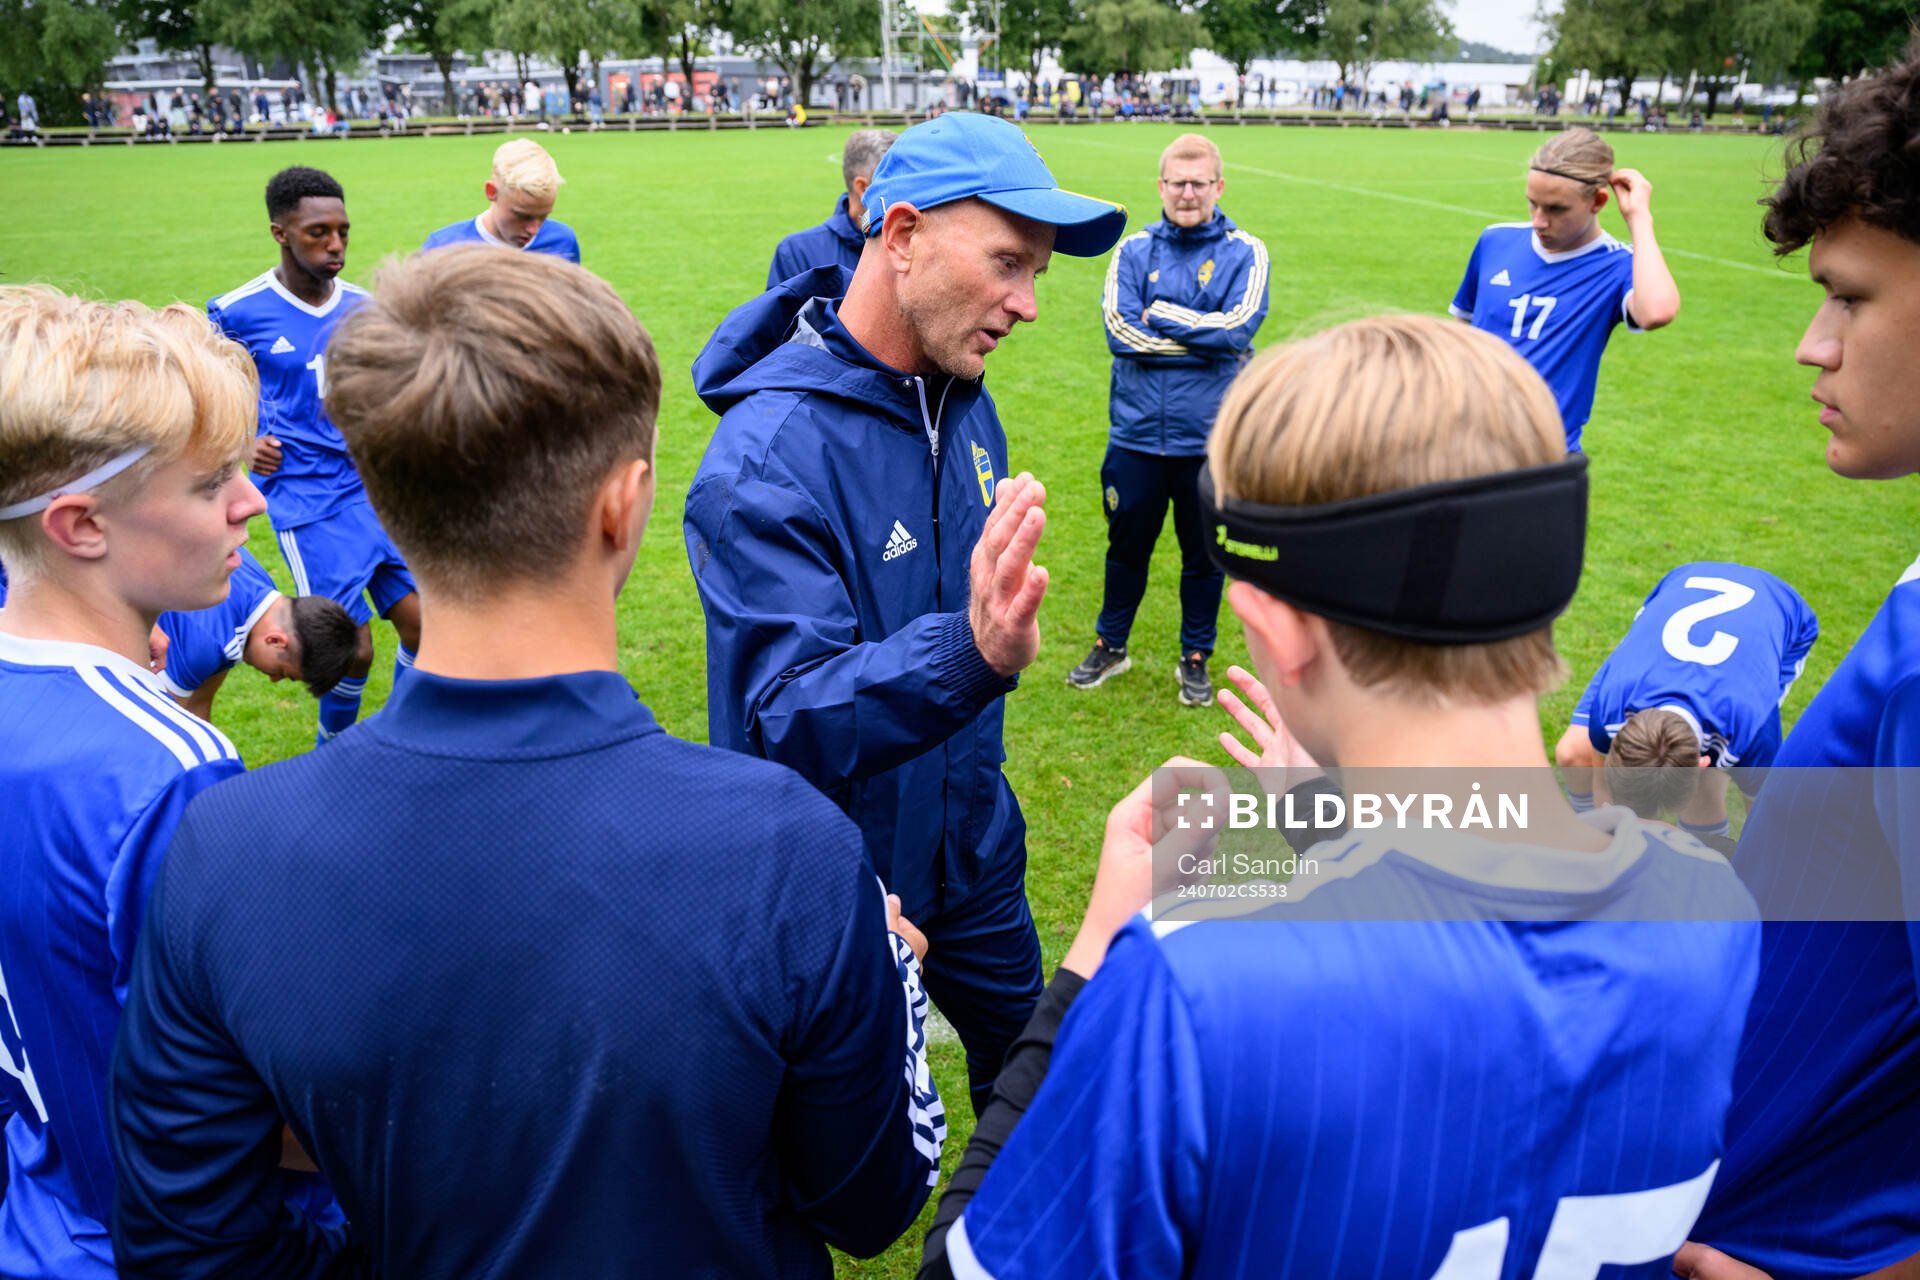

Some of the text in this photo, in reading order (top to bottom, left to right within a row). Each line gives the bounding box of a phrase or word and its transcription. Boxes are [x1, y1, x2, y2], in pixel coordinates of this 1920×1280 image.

[1509, 293, 1557, 340] 17
[882, 538, 918, 561] adidas
[1662, 576, 1756, 666] 2
